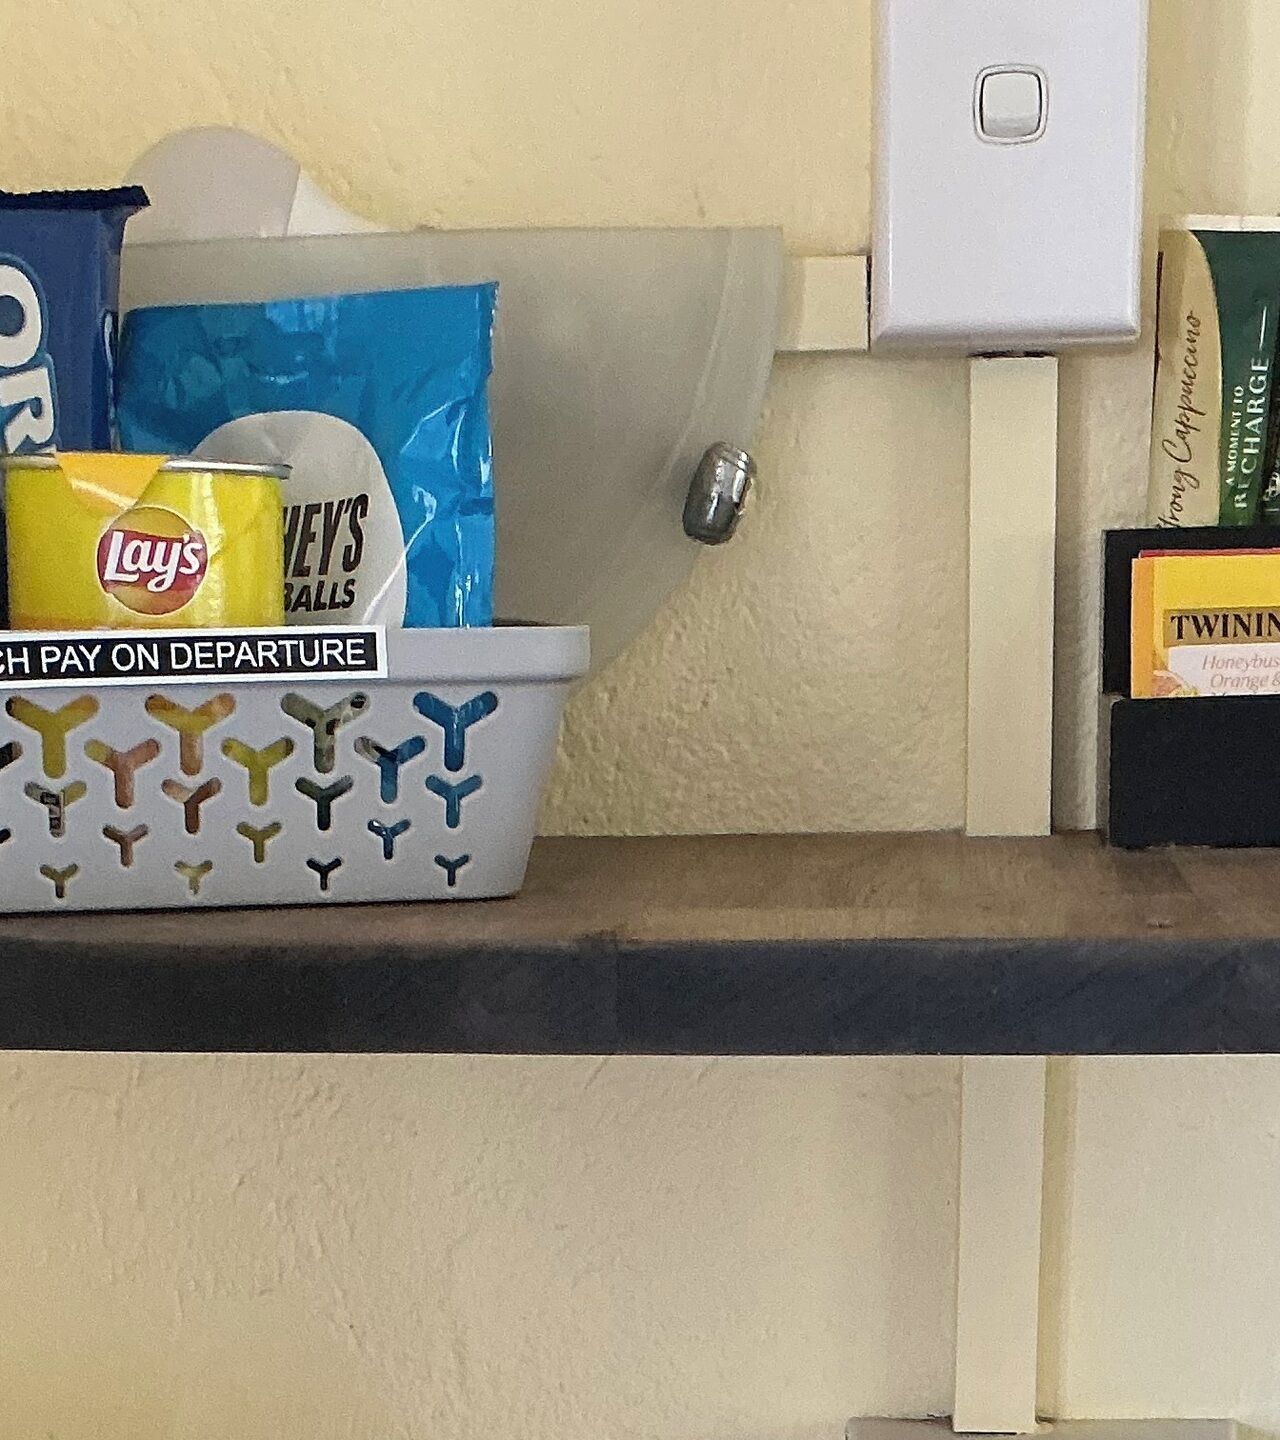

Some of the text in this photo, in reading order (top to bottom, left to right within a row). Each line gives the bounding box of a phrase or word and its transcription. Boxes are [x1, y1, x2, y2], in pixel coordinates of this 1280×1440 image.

[1161, 310, 1207, 464] Cappuccino
[1225, 384, 1245, 487] A MOMENT TO
[1234, 356, 1270, 509] RECHARGE
[103, 530, 204, 593] Lay's
[41, 643, 102, 675] PAY
[111, 642, 161, 672] ON
[170, 638, 367, 670] DEPARTURE
[1210, 673, 1270, 691] Orange
